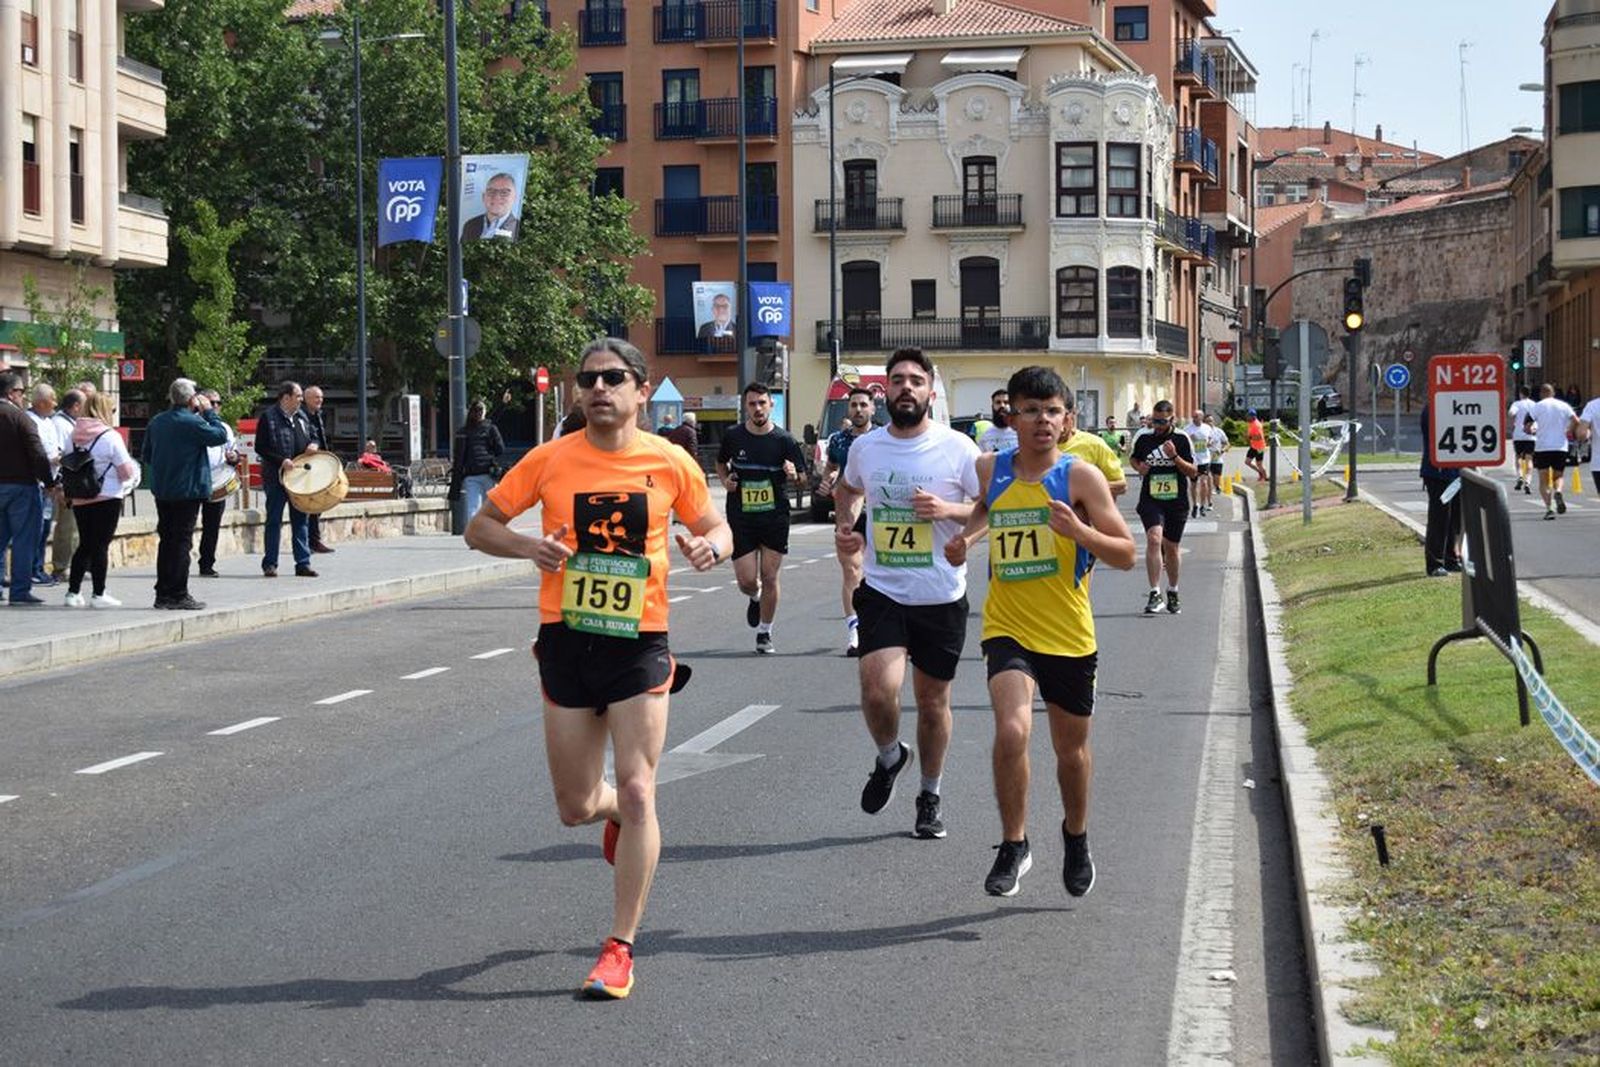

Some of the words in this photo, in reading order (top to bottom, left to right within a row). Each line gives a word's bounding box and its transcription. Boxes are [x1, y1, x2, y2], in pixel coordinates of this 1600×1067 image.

[388, 179, 426, 193] VOTA
[758, 296, 783, 305] VOTA
[1436, 364, 1497, 385] N-122
[1452, 399, 1482, 416] km
[1438, 424, 1498, 454] 459
[1156, 482, 1171, 492] 75
[744, 489, 769, 503] 170
[885, 526, 916, 549] 74
[996, 529, 1039, 559] 171
[572, 576, 632, 612] 159
[582, 618, 604, 628] CAJA
[605, 620, 635, 631] RURAL
